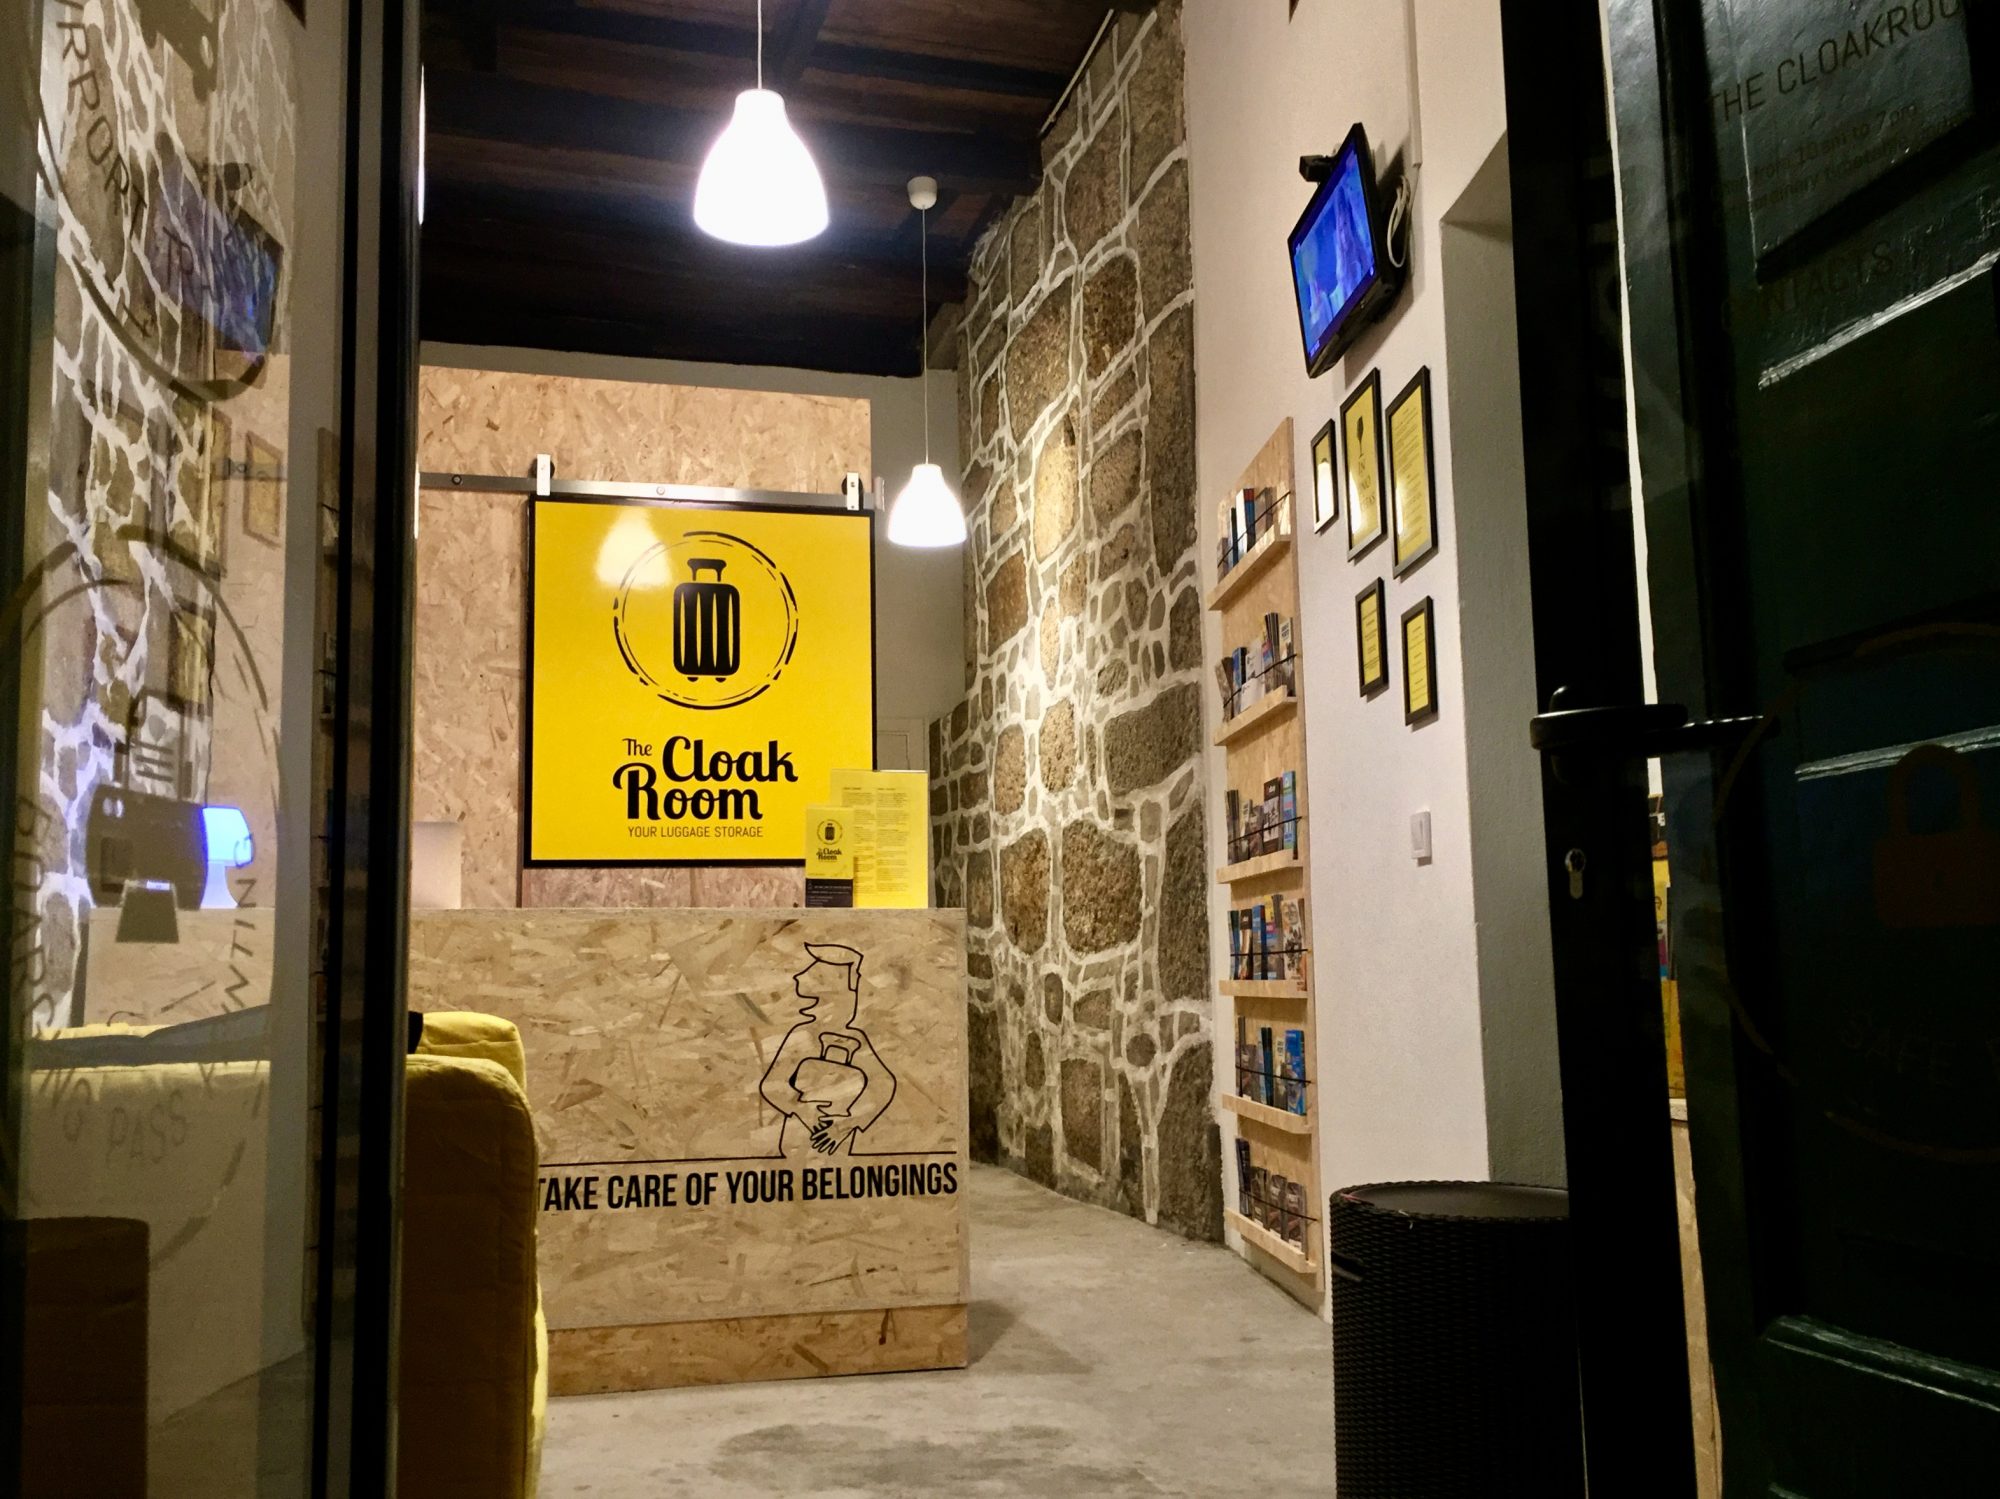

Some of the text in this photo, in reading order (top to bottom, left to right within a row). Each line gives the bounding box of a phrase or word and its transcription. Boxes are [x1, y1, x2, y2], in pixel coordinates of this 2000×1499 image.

[622, 735, 799, 783] The Cloak
[612, 762, 763, 821] Room
[628, 826, 763, 838] YOUR LUGGAGE STORAGE
[105, 1090, 190, 1168] PASS
[607, 1174, 678, 1209] CARE
[685, 1172, 719, 1207] OF
[725, 1169, 794, 1204] YOUR
[801, 1161, 959, 1201] BELONGINGS
